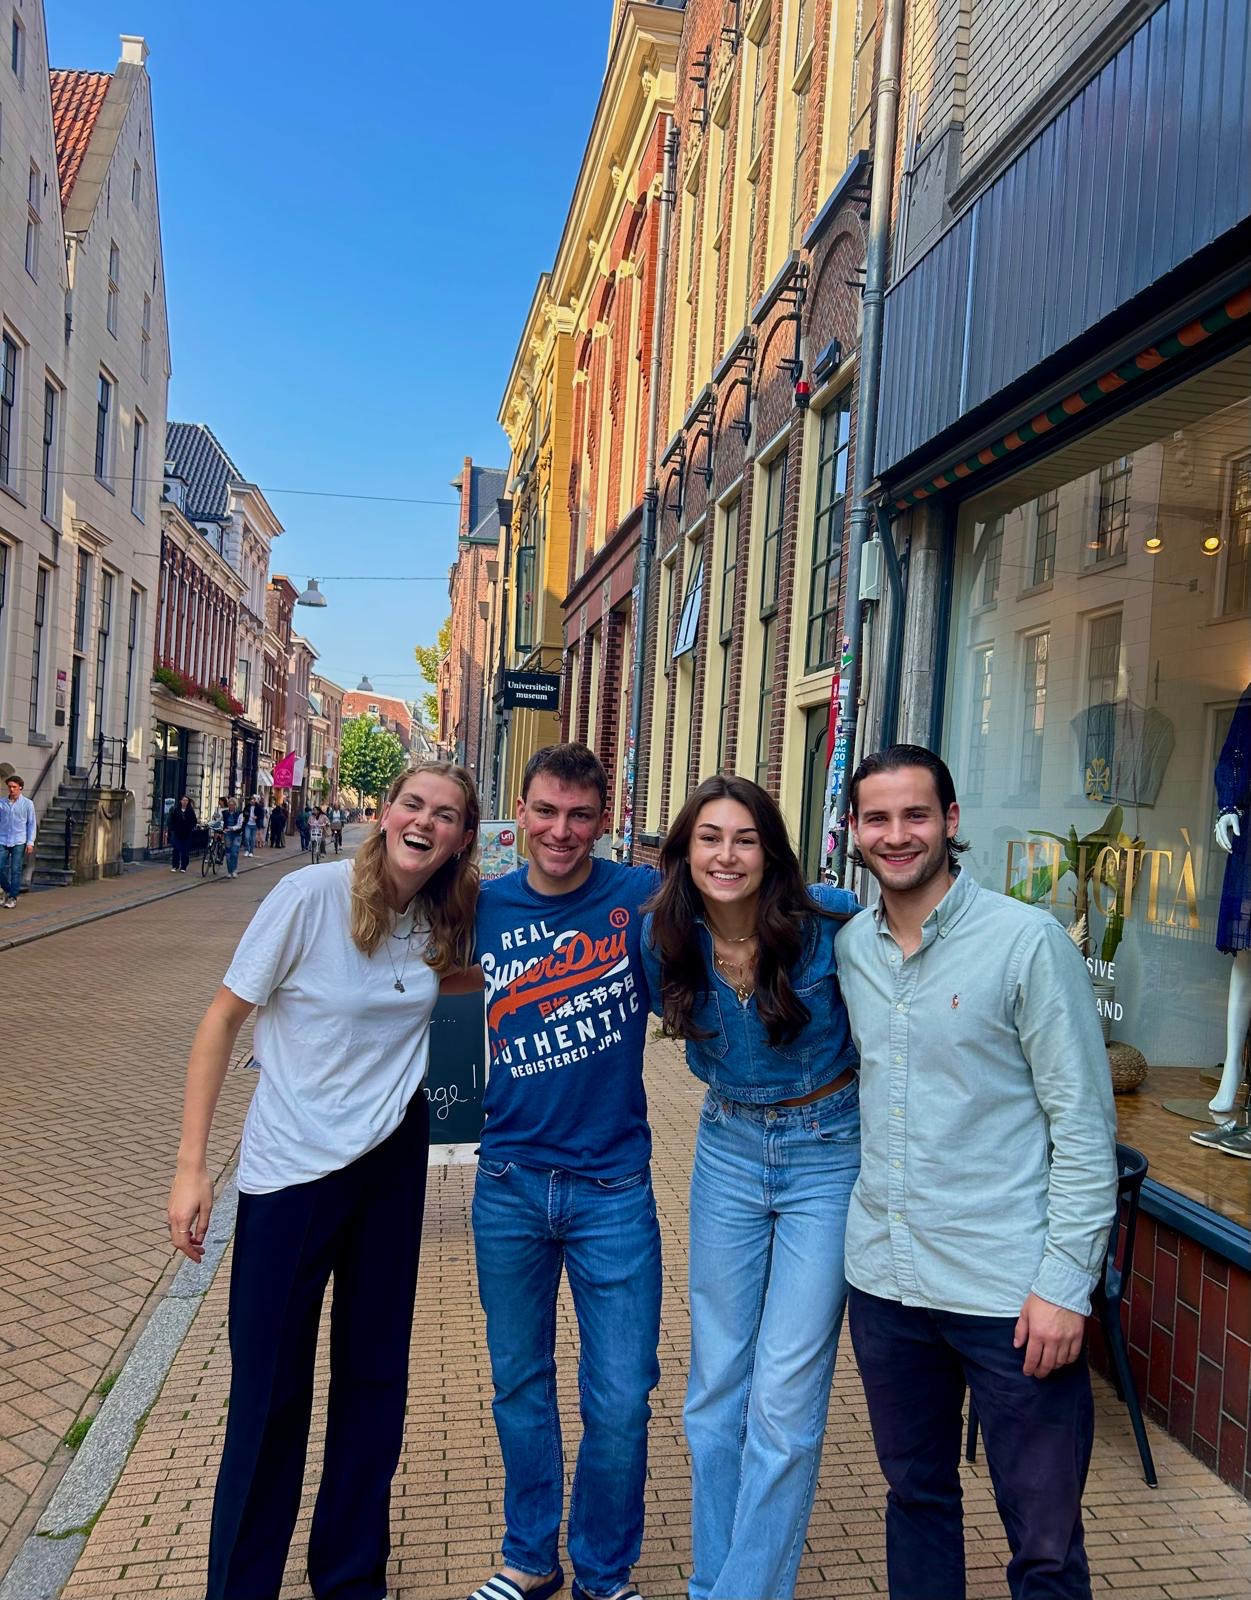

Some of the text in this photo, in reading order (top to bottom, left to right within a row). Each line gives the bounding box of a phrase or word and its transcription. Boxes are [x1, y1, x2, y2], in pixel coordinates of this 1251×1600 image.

[507, 680, 557, 692] Universiteits-
[515, 692, 548, 701] museum
[1005, 827, 1200, 929] FELICITÀ
[501, 920, 556, 951] REAL
[1082, 956, 1116, 981] SIVE
